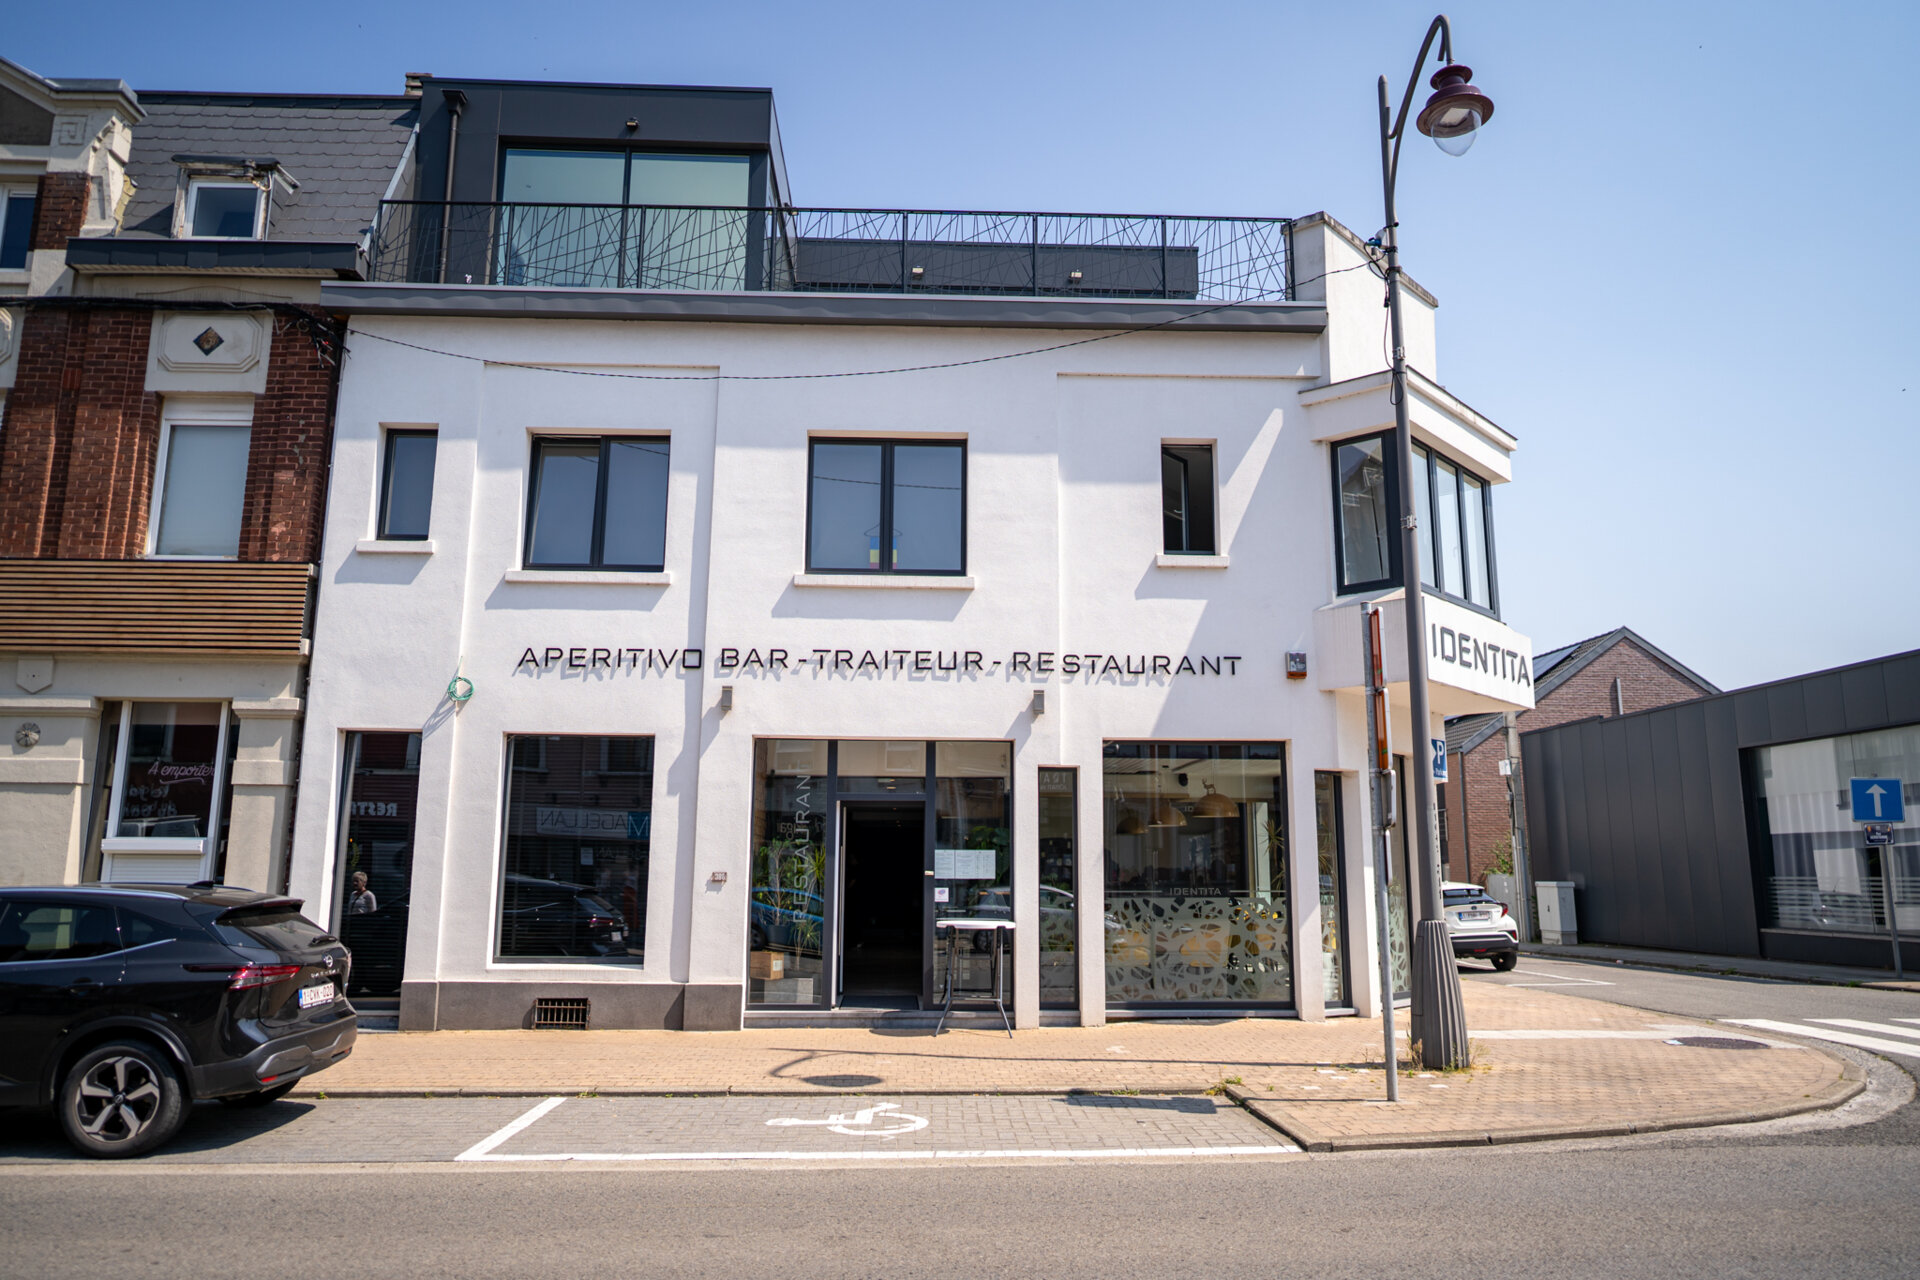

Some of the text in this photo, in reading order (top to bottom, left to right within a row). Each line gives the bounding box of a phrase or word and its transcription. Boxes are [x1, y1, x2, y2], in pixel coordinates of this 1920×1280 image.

[517, 647, 702, 669] APERITIVO
[1431, 623, 1531, 687] IDENTITA
[1436, 741, 1445, 765] P
[1169, 887, 1221, 896] IDENTITA
